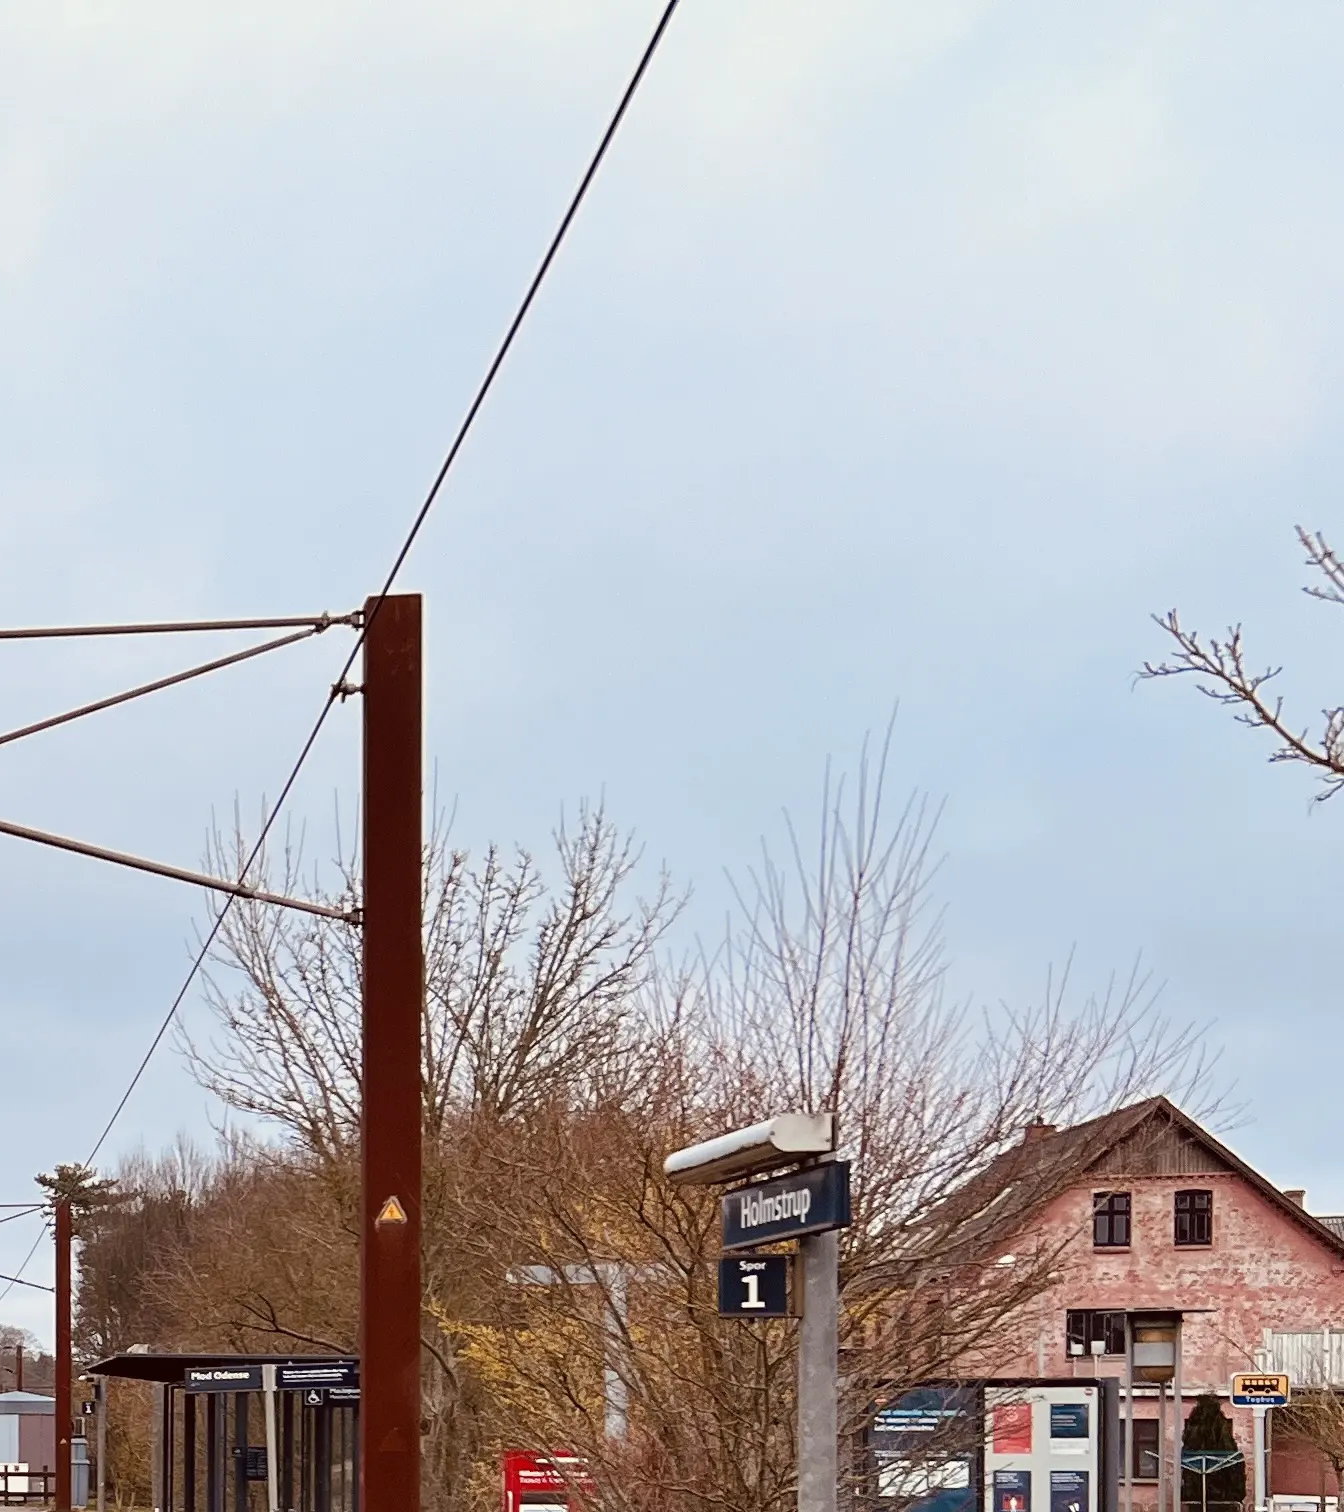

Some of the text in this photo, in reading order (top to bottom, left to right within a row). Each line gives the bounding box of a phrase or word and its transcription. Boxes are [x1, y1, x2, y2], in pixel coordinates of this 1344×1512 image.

[740, 1187, 811, 1229] Holmstrup
[739, 1260, 767, 1272] Spor
[740, 1274, 766, 1309] 1
[191, 1371, 250, 1380] Mod Odense
